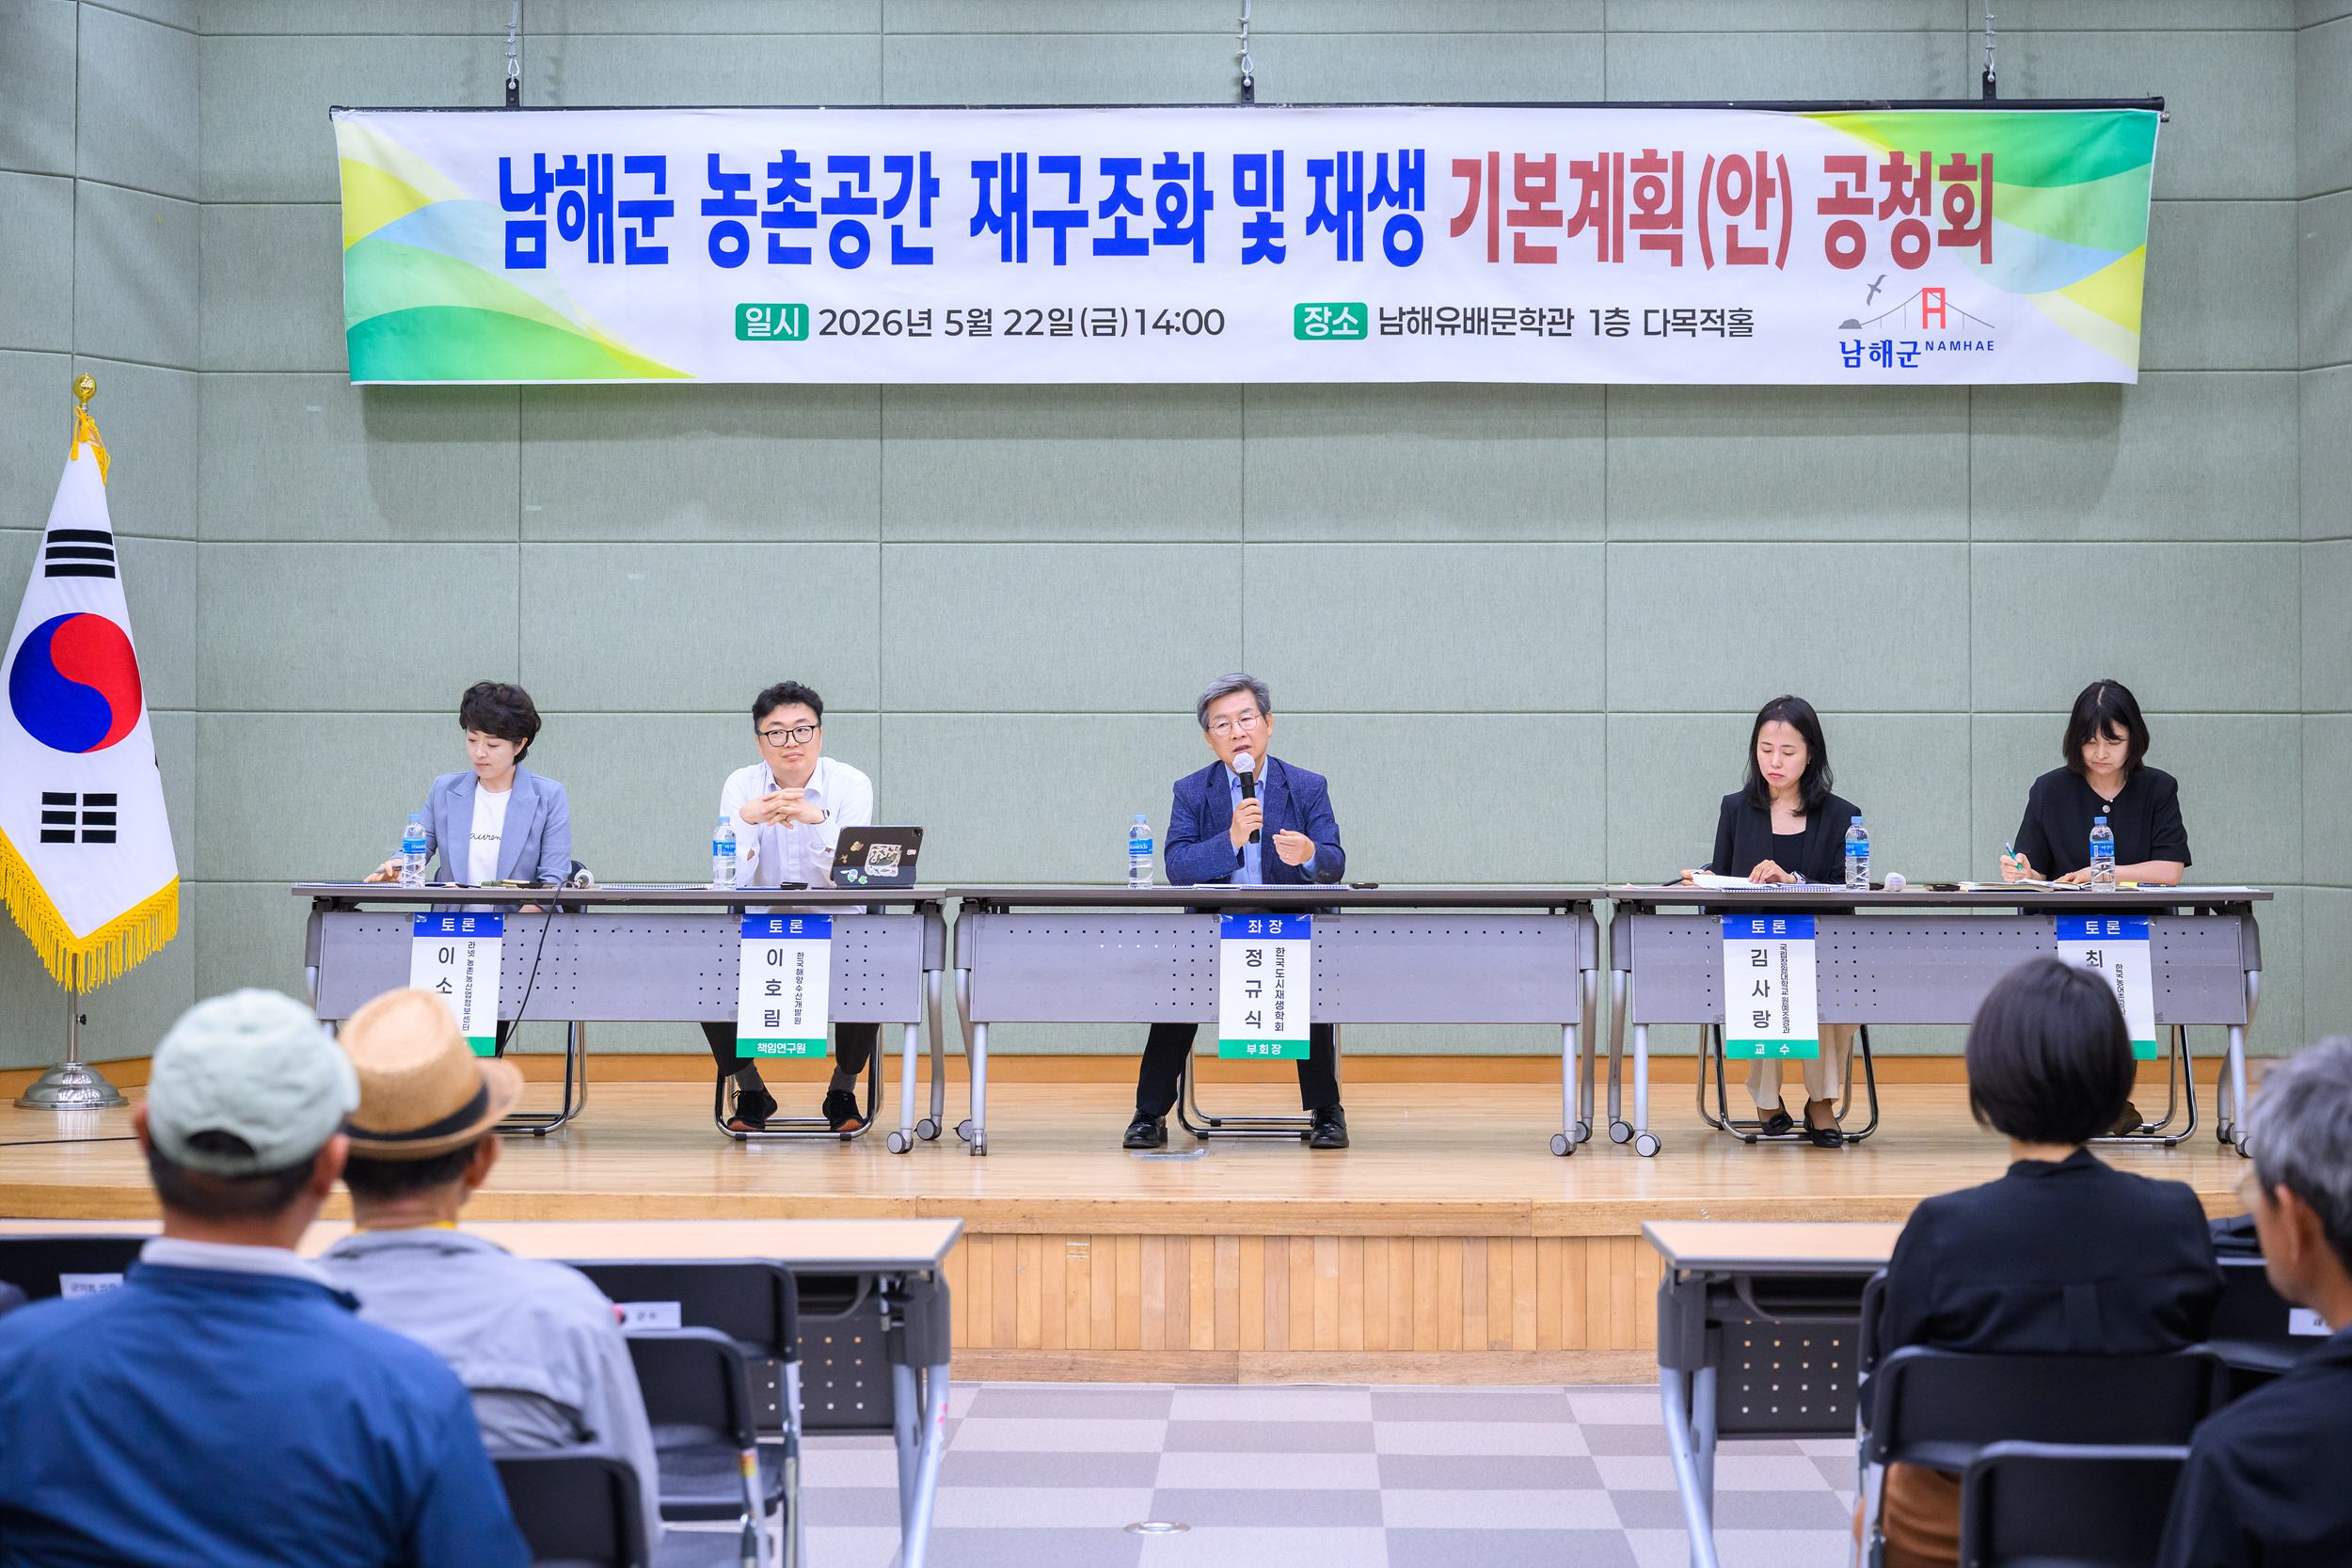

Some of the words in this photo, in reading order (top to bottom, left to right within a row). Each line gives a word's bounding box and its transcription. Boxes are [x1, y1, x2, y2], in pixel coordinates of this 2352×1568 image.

[499, 152, 675, 270] 남해군
[700, 149, 941, 270] 농촌공간
[969, 150, 1215, 266] 재구조화
[1232, 150, 1287, 265] 및
[1305, 148, 1425, 268] 재생
[1450, 149, 1792, 269] 기본계획(안)
[1817, 150, 1994, 269] 공청회
[745, 308, 799, 337] 일시
[818, 308, 932, 338] 2026년
[944, 308, 993, 337] 5월
[1304, 307, 1359, 337] 장소
[1379, 306, 1575, 337] 남해유배문학관
[1589, 307, 1630, 338] 1층
[1644, 307, 1755, 338] 다목적홀
[1839, 339, 1922, 369] 남해군
[1925, 340, 1994, 352] NAMHAE
[441, 917, 475, 932] 토론
[769, 919, 803, 934] 토론
[1248, 919, 1283, 934] 좌장
[1751, 919, 1787, 934] 토론
[2085, 920, 2121, 935] 토론
[794, 951, 804, 1025] 한국해양수산개발원
[1275, 946, 1286, 1032] 한국도시재생학회
[757, 1042, 806, 1054] 책임연구원
[1247, 1043, 1282, 1055] 부회장
